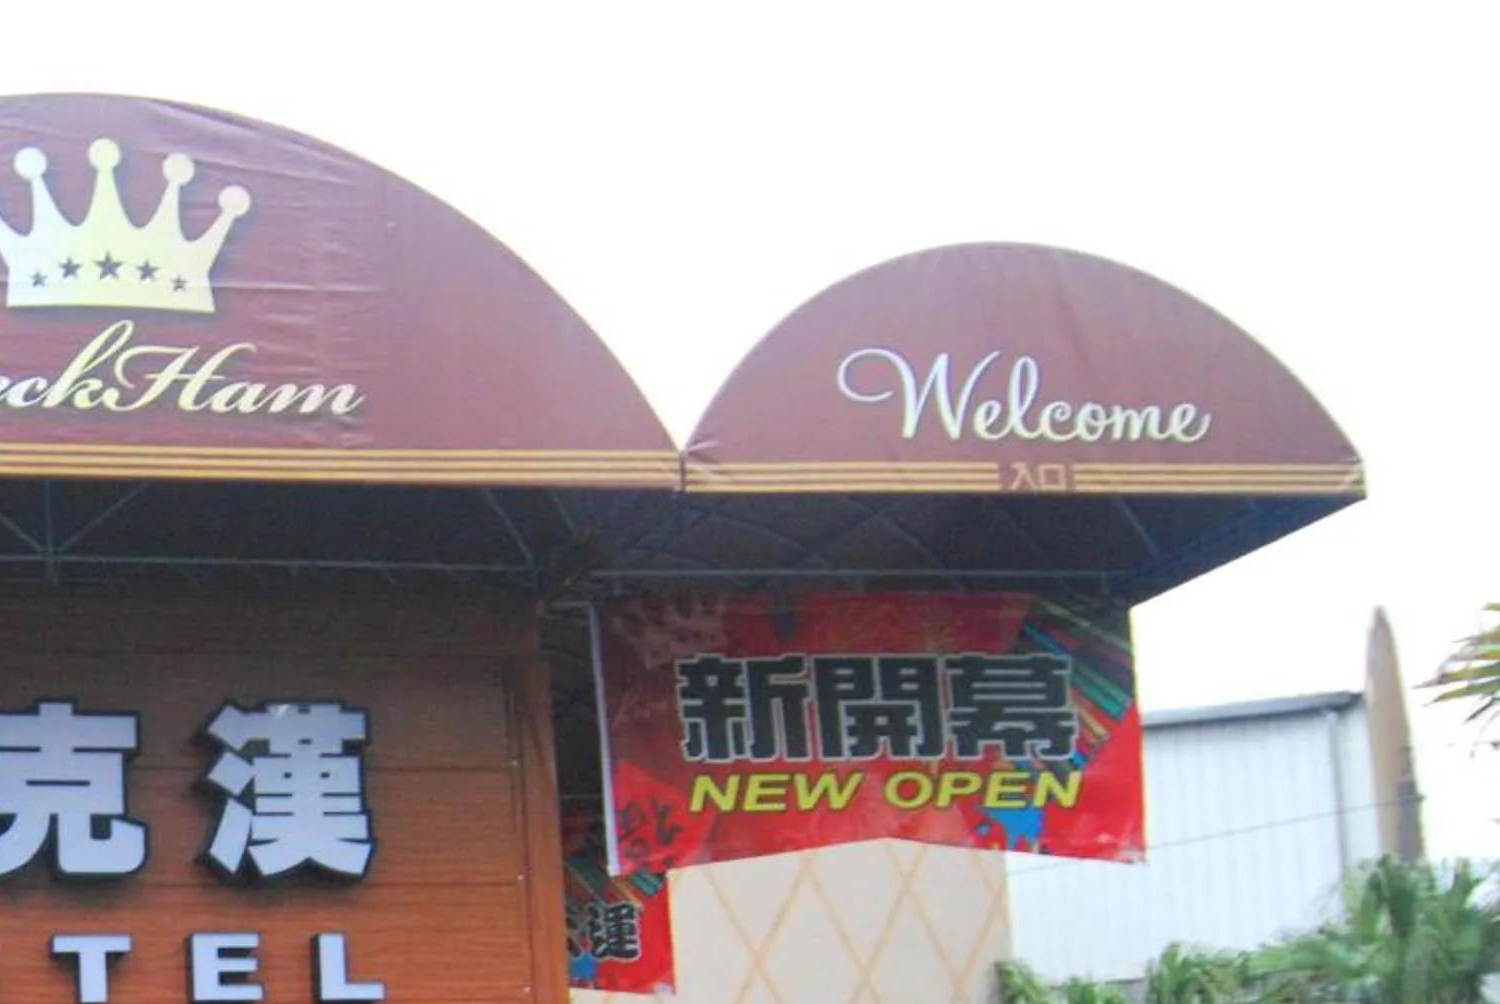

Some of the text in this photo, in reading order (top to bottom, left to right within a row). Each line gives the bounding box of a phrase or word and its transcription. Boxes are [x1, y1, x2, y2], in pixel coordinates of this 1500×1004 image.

[837, 348, 1213, 442] Welcome
[1009, 463, 1068, 491] 入口
[675, 652, 1080, 763] 新開幕
[688, 770, 1083, 812] NEW OPEN
